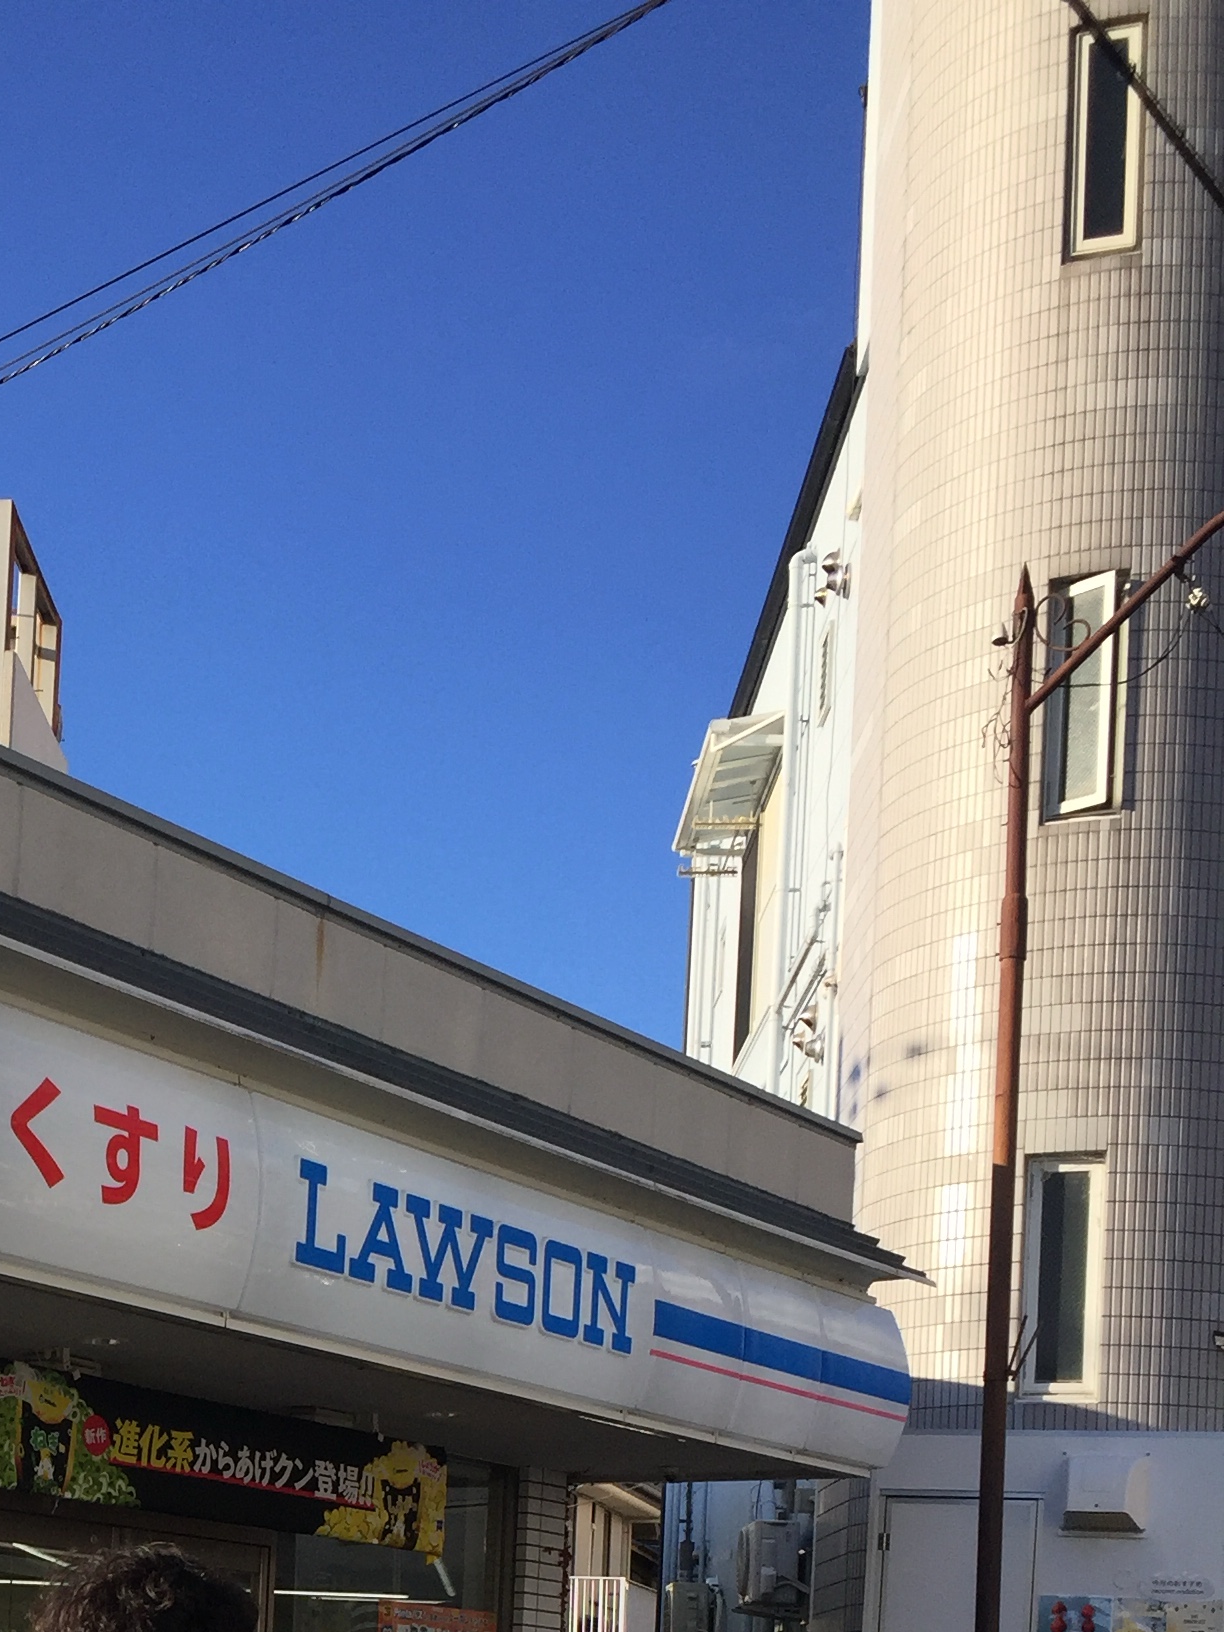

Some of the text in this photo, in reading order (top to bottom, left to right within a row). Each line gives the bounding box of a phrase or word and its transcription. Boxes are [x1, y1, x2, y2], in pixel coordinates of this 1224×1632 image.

[8, 1076, 234, 1231] くすり
[292, 1157, 637, 1356] LAWSON
[83, 1427, 107, 1445] 新作
